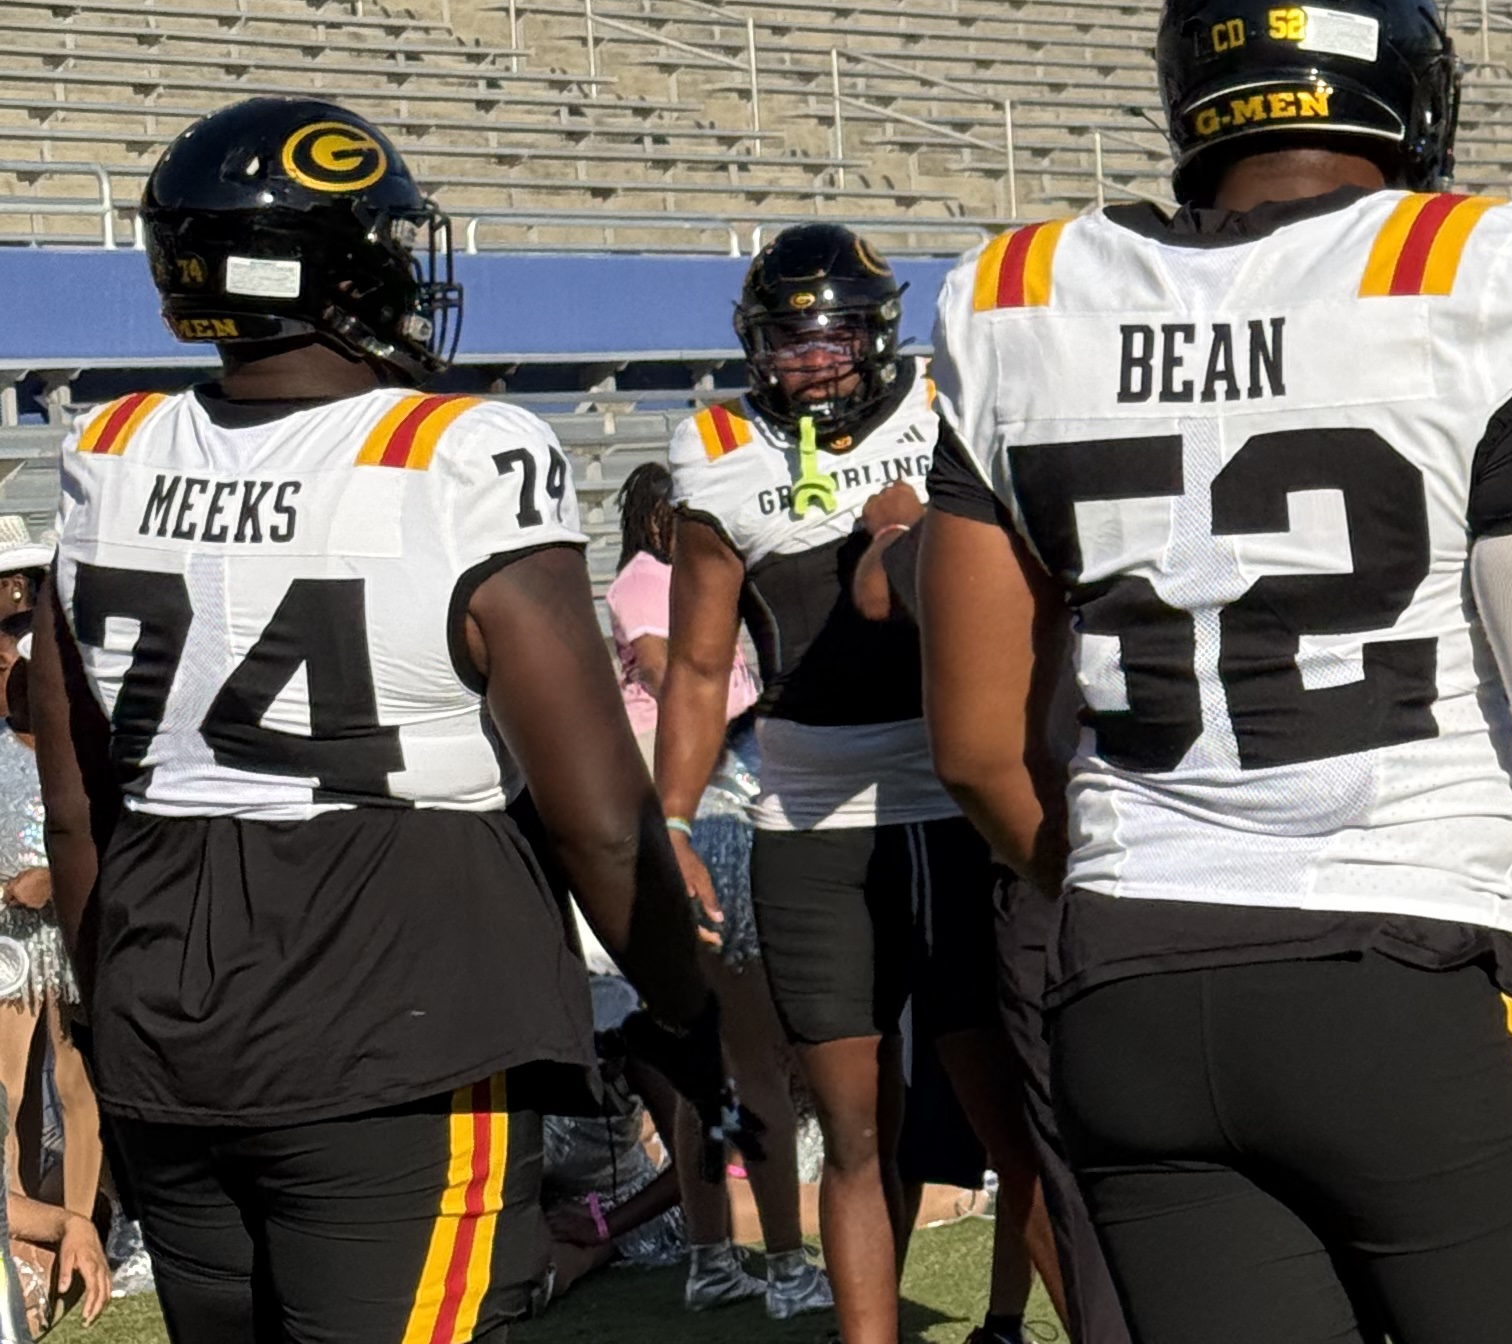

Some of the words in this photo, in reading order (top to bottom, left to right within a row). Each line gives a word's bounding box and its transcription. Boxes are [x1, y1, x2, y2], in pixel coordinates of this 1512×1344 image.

[1211, 18, 1246, 52] CD
[1268, 8, 1306, 41] 52
[1117, 317, 1287, 404] BEAN
[139, 474, 302, 543] MEEKS
[1006, 427, 1440, 773] 52
[74, 561, 415, 808] 74
